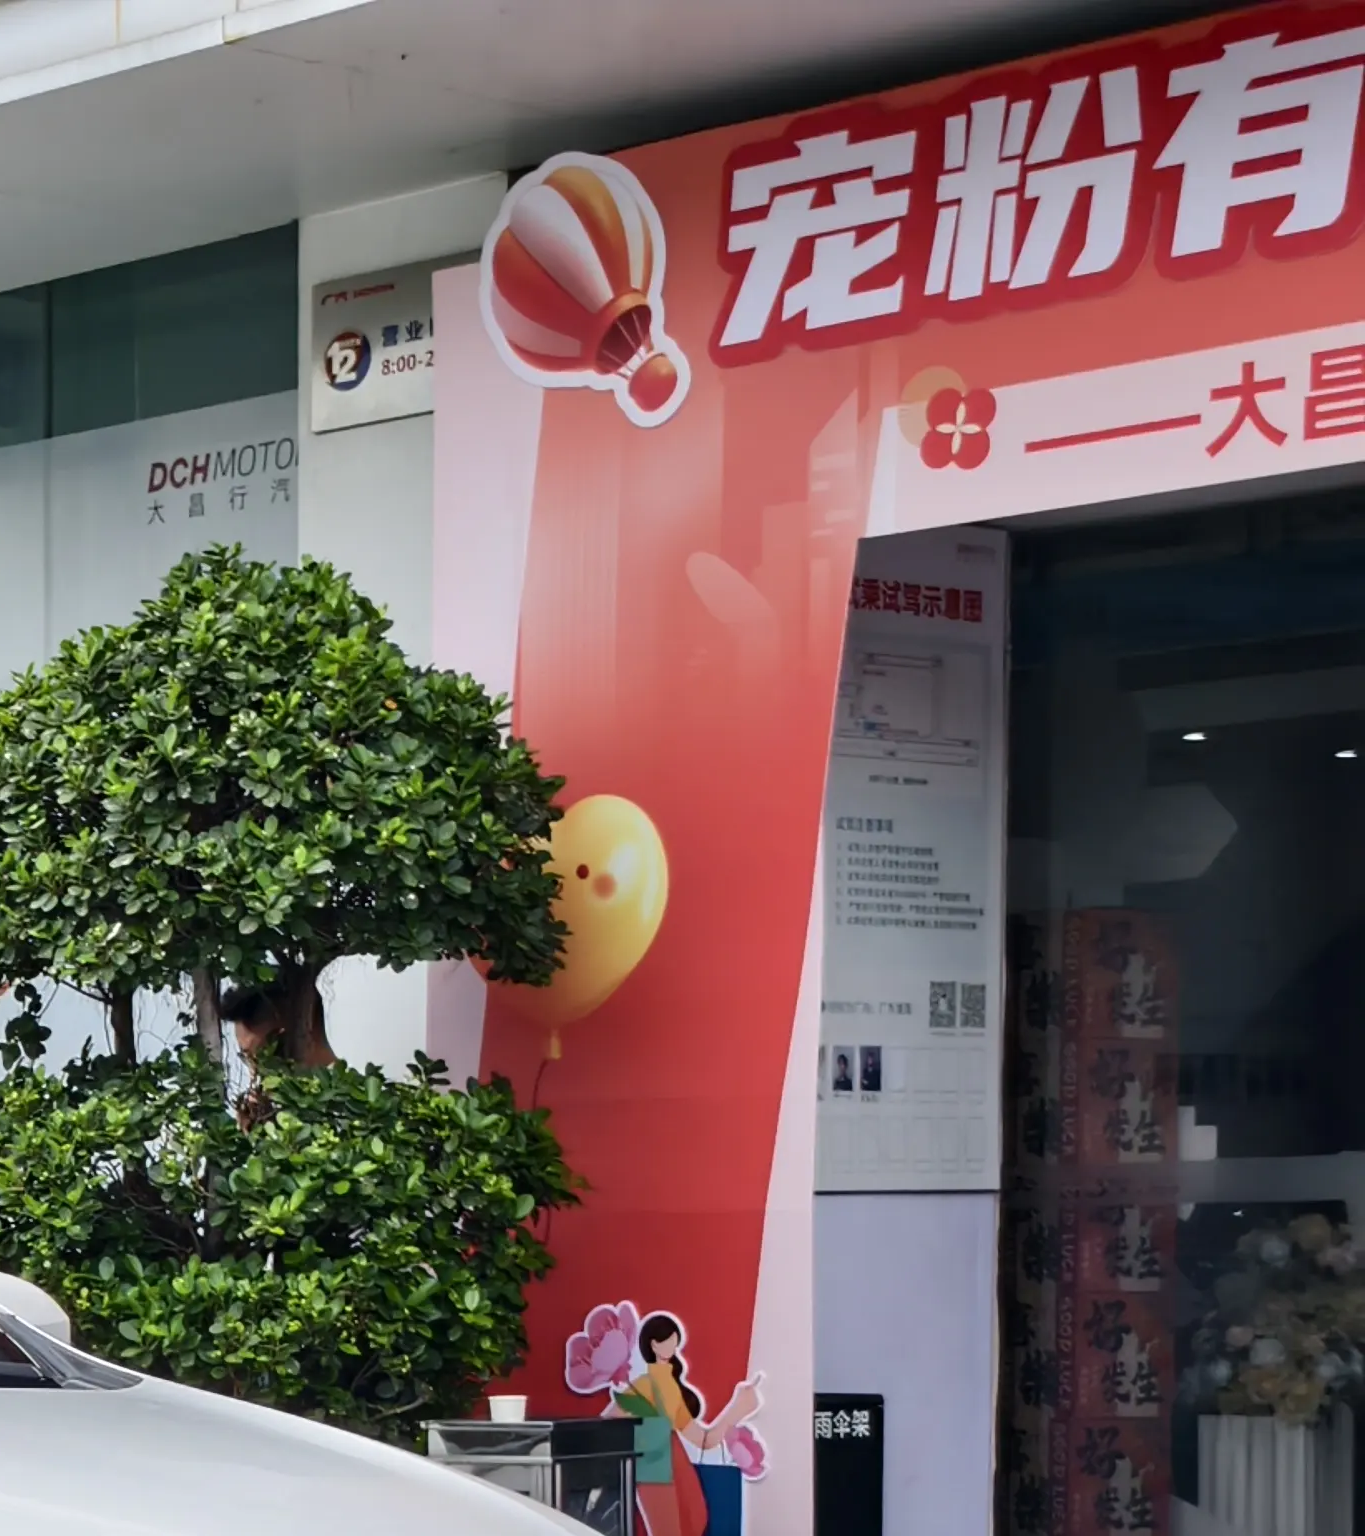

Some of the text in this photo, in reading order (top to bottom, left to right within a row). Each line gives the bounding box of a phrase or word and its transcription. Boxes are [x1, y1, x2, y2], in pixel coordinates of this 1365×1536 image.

[718, 25, 1365, 348] 宠粉有
[381, 316, 434, 348] 营业
[147, 437, 300, 494] DCHMOTO
[814, 1409, 871, 1439] 雨伞架
